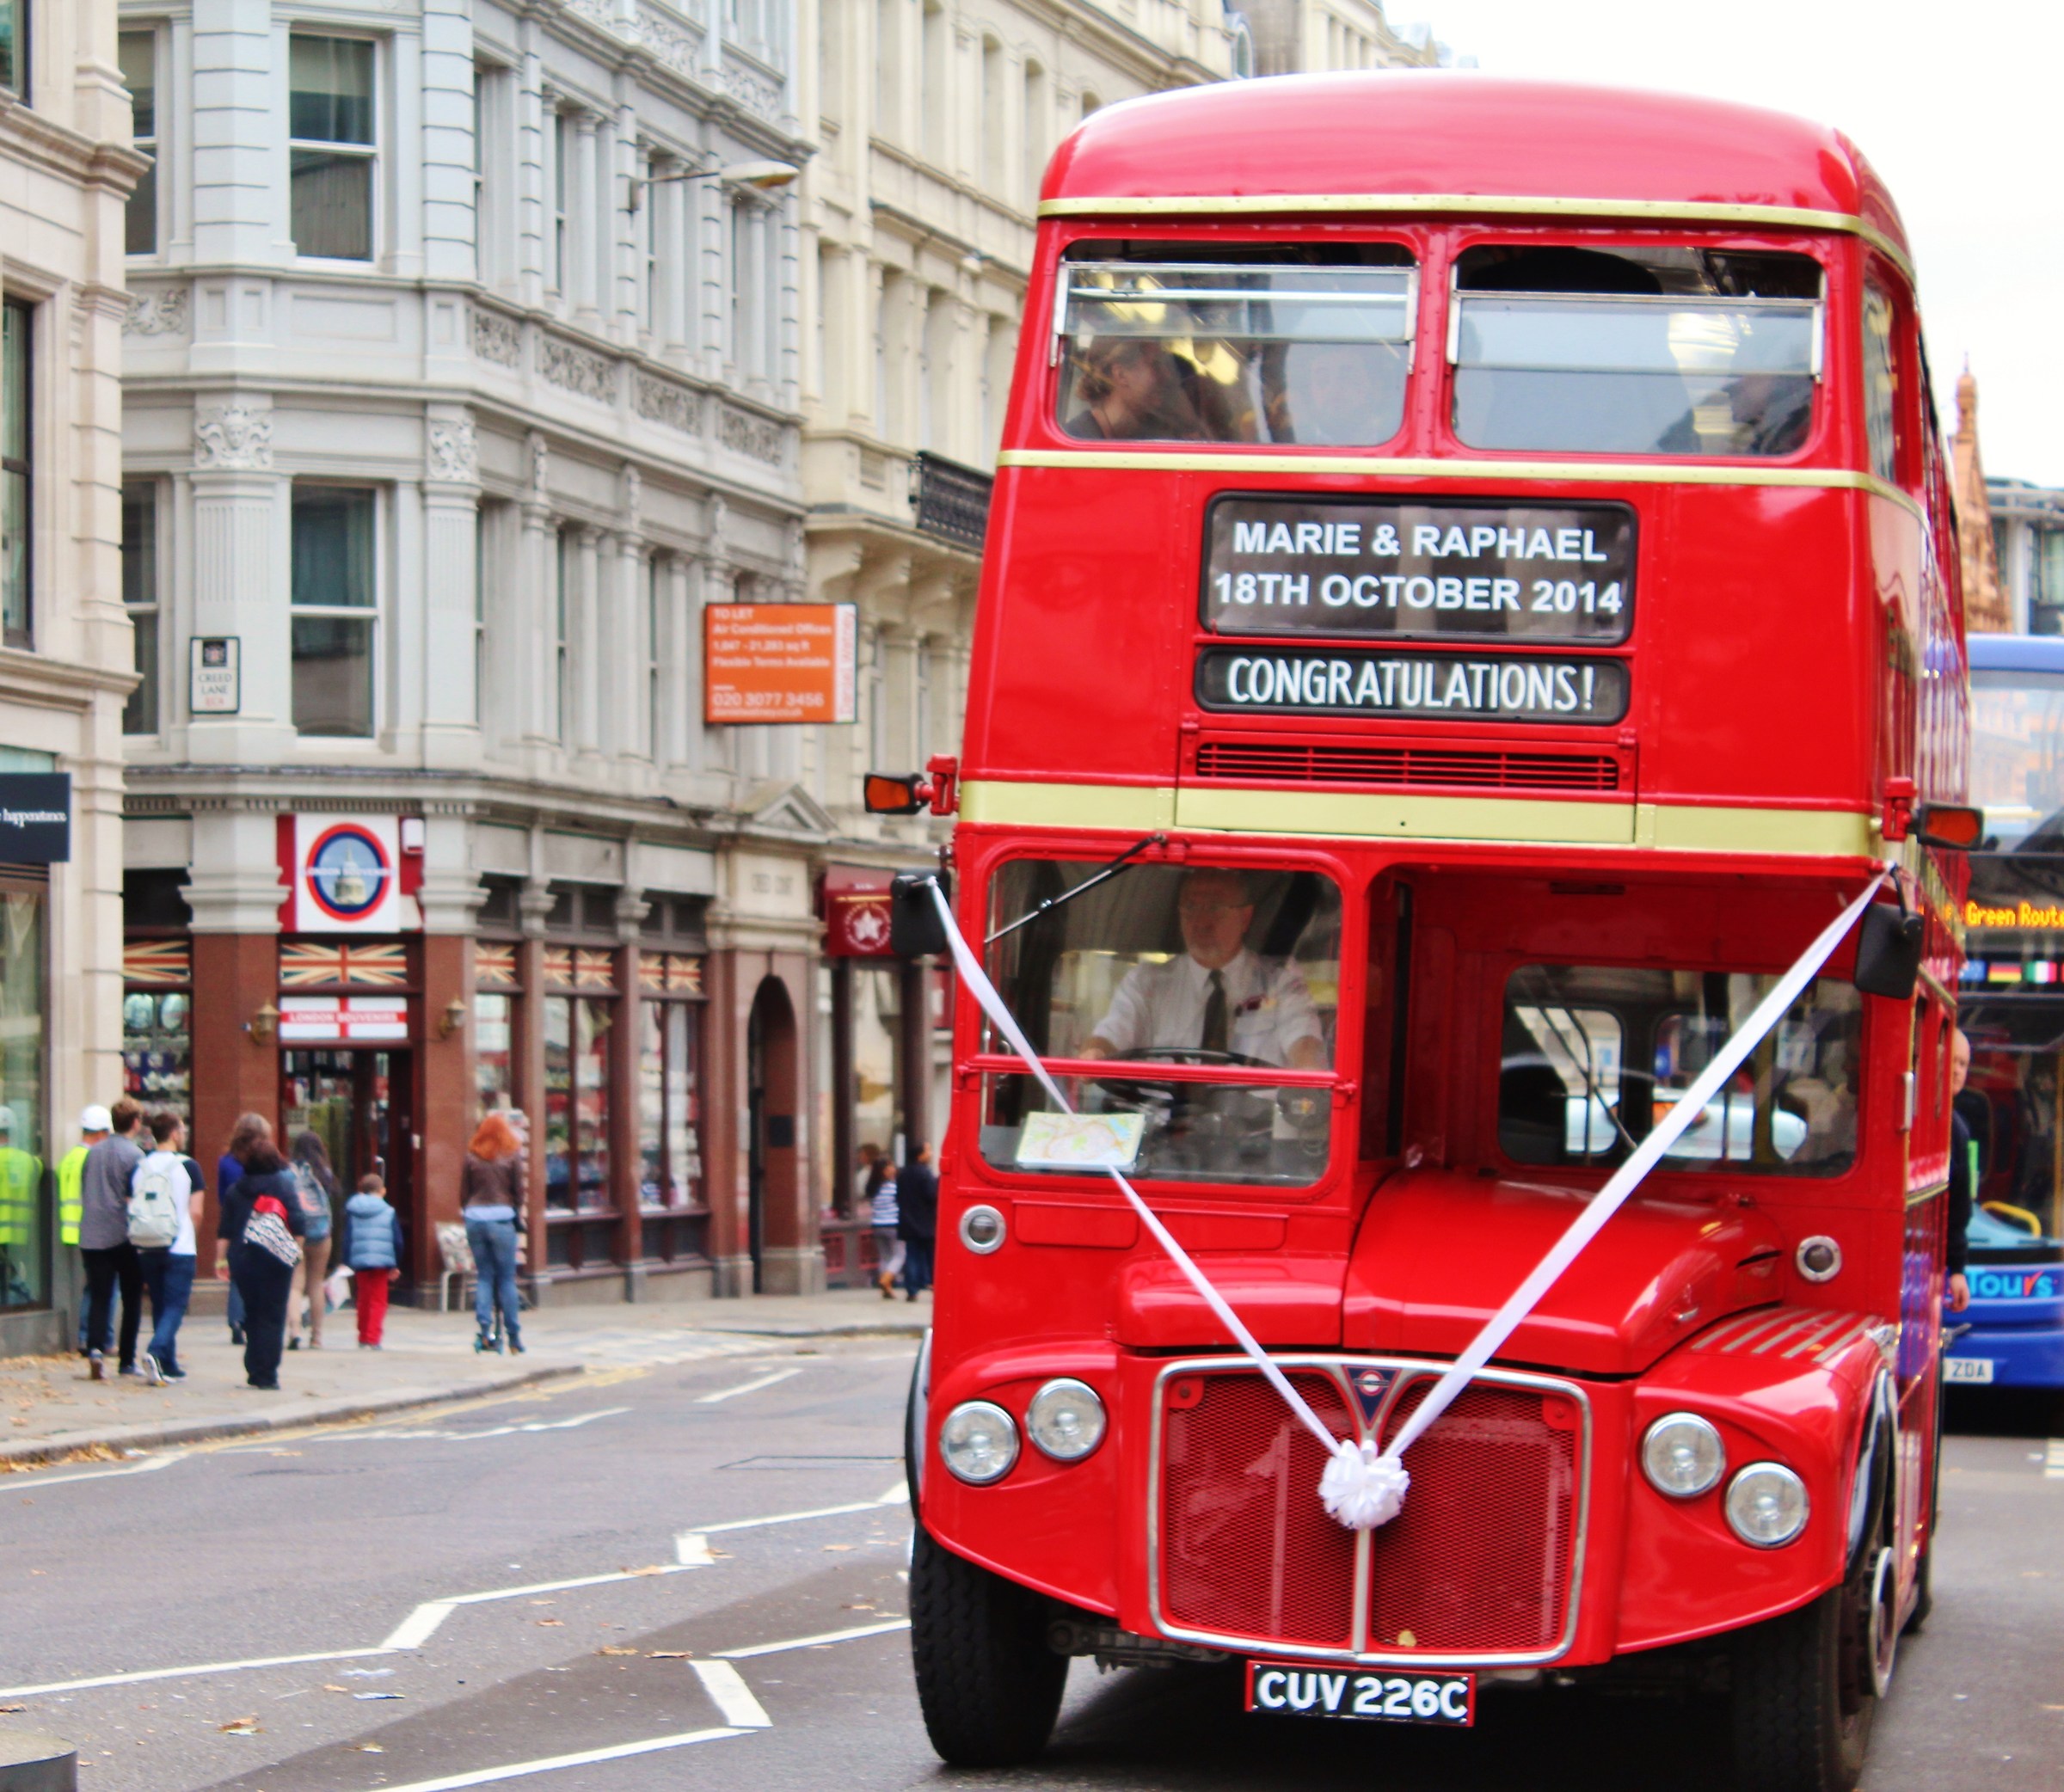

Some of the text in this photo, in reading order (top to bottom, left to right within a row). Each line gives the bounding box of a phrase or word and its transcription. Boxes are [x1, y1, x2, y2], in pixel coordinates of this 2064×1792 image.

[1233, 522, 1607, 562] MARIE & RAPHAEL
[1214, 573, 1622, 614] 18TH OCTOBER 2014
[713, 607, 754, 620] TO LET
[198, 673, 232, 683] CREED
[201, 684, 228, 695] LANE
[1227, 657, 1594, 712] CONGRATULATIONS!
[712, 692, 825, 708] 020 3077 3456
[1966, 899, 2017, 927] Green
[289, 1011, 334, 1024] LONDON
[1964, 1265, 2054, 1298] Tours
[1256, 1671, 1469, 1719] CUV 226C
